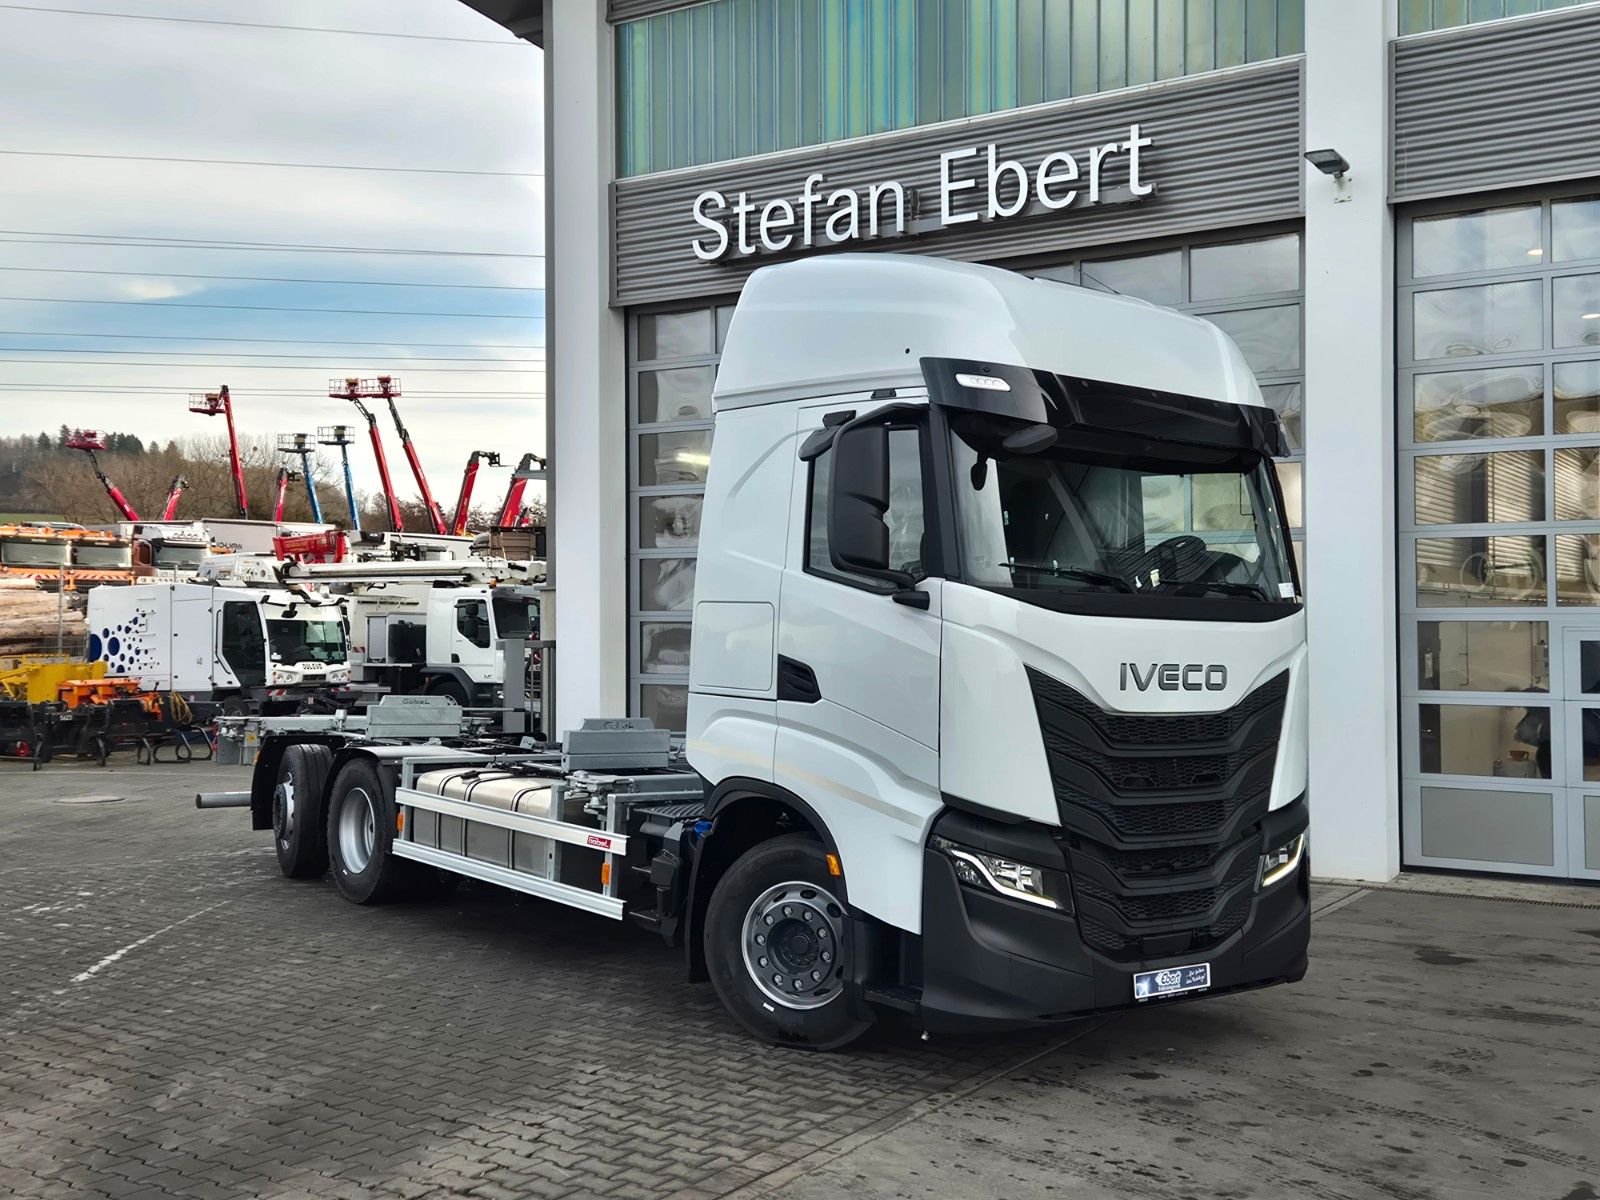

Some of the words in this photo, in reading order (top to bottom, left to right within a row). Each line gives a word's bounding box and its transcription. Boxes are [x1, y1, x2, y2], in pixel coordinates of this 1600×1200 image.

[692, 173, 907, 261] Stefan
[940, 123, 1154, 226] Ebert
[1120, 662, 1228, 692] IVECO
